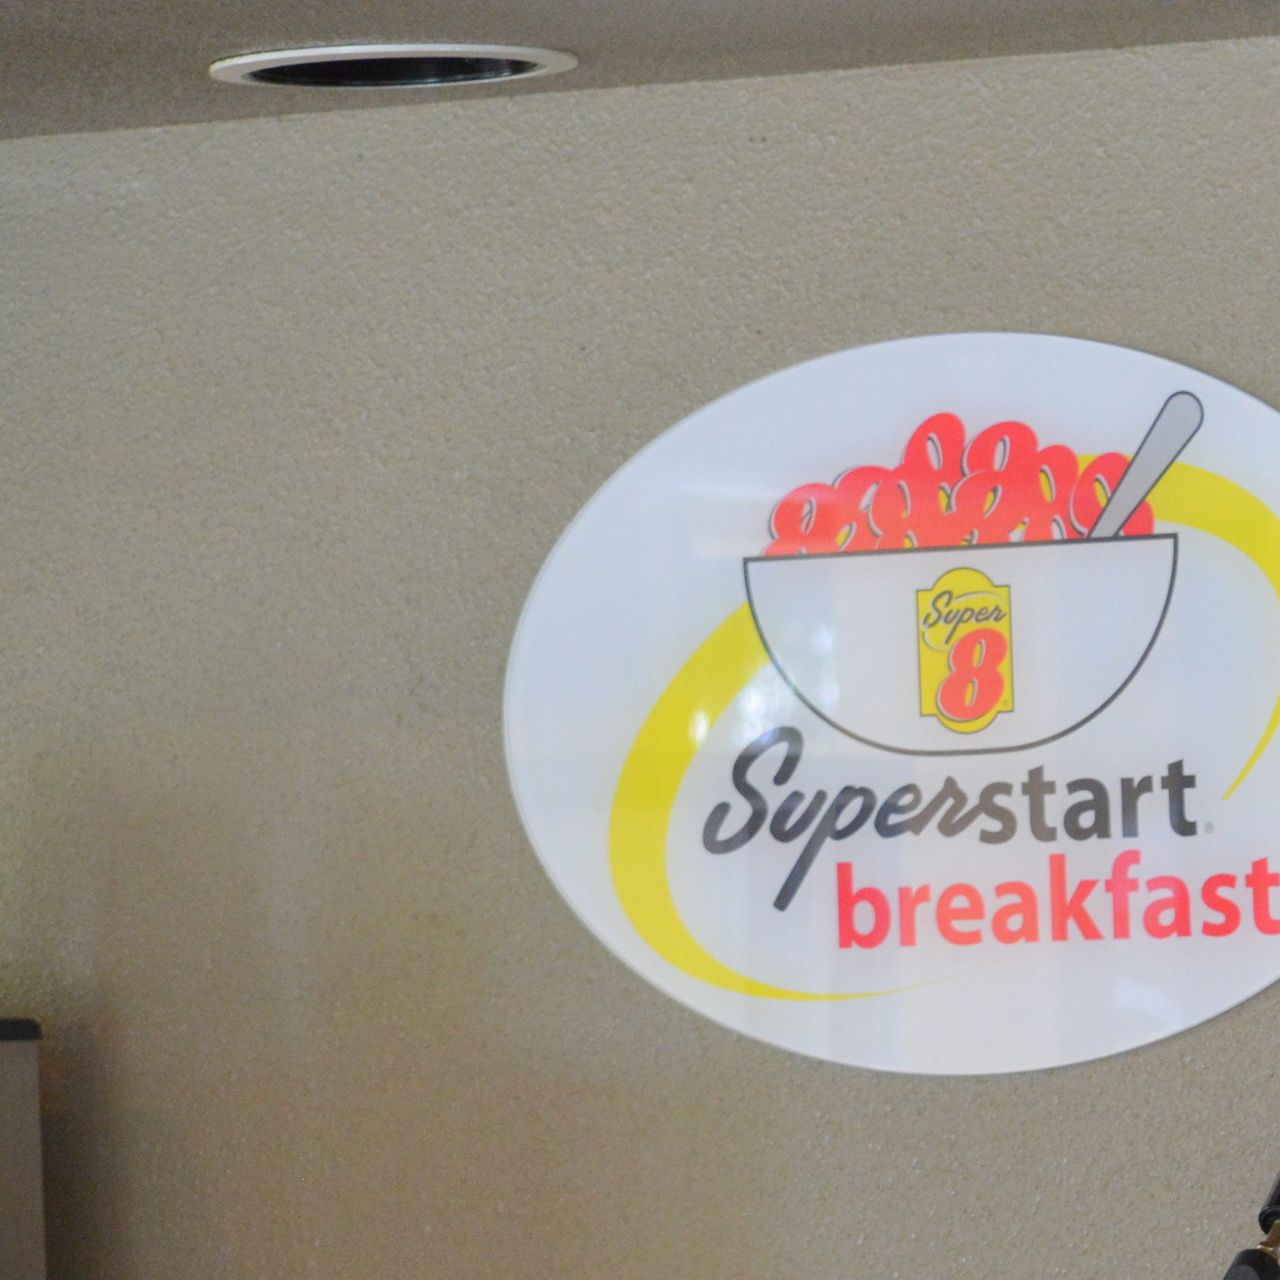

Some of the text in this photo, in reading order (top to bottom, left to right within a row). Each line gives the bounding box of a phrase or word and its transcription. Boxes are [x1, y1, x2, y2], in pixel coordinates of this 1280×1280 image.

[922, 590, 1008, 645] Super
[936, 627, 1009, 723] 8
[702, 726, 1197, 912] Superstart
